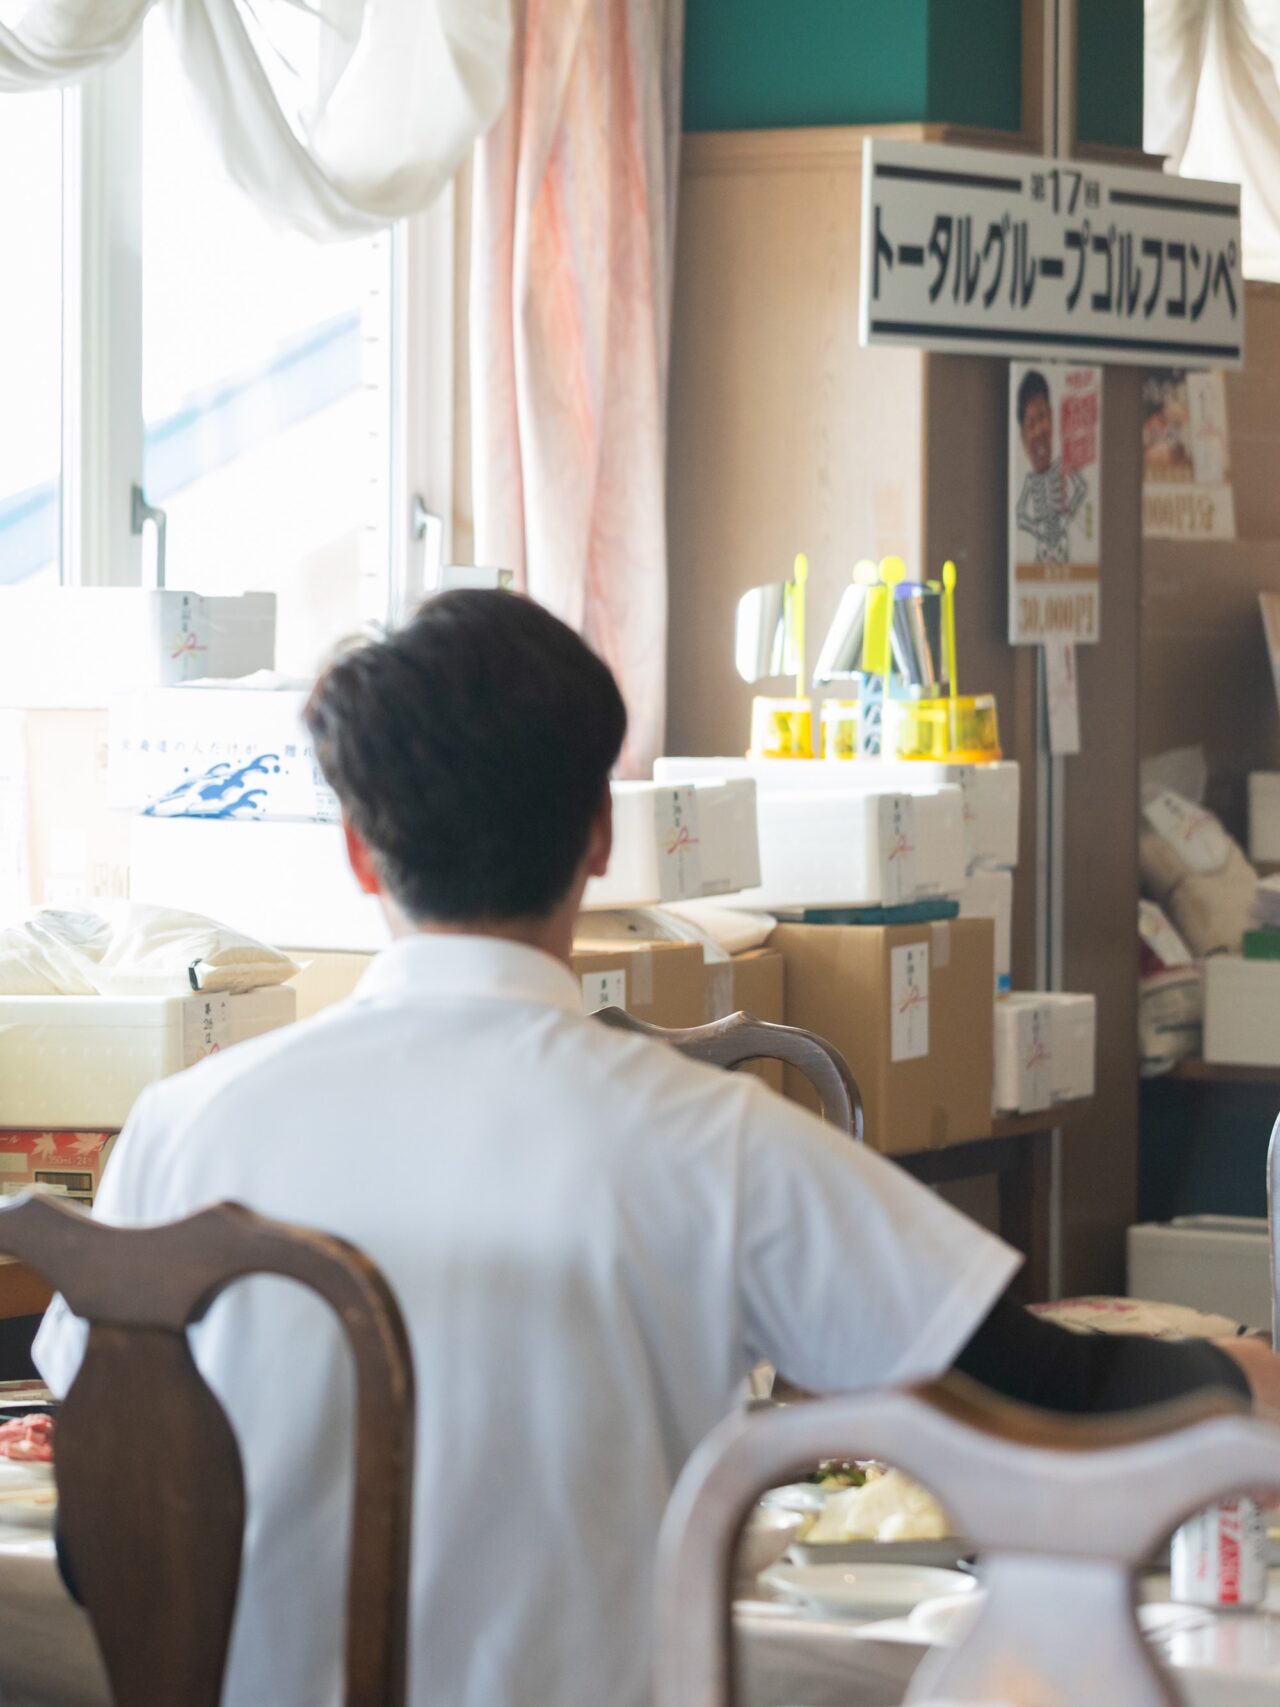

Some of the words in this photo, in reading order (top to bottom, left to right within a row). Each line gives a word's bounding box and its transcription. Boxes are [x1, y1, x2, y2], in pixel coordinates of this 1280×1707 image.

[873, 205, 1238, 322] トータルグループゴルフコンペ
